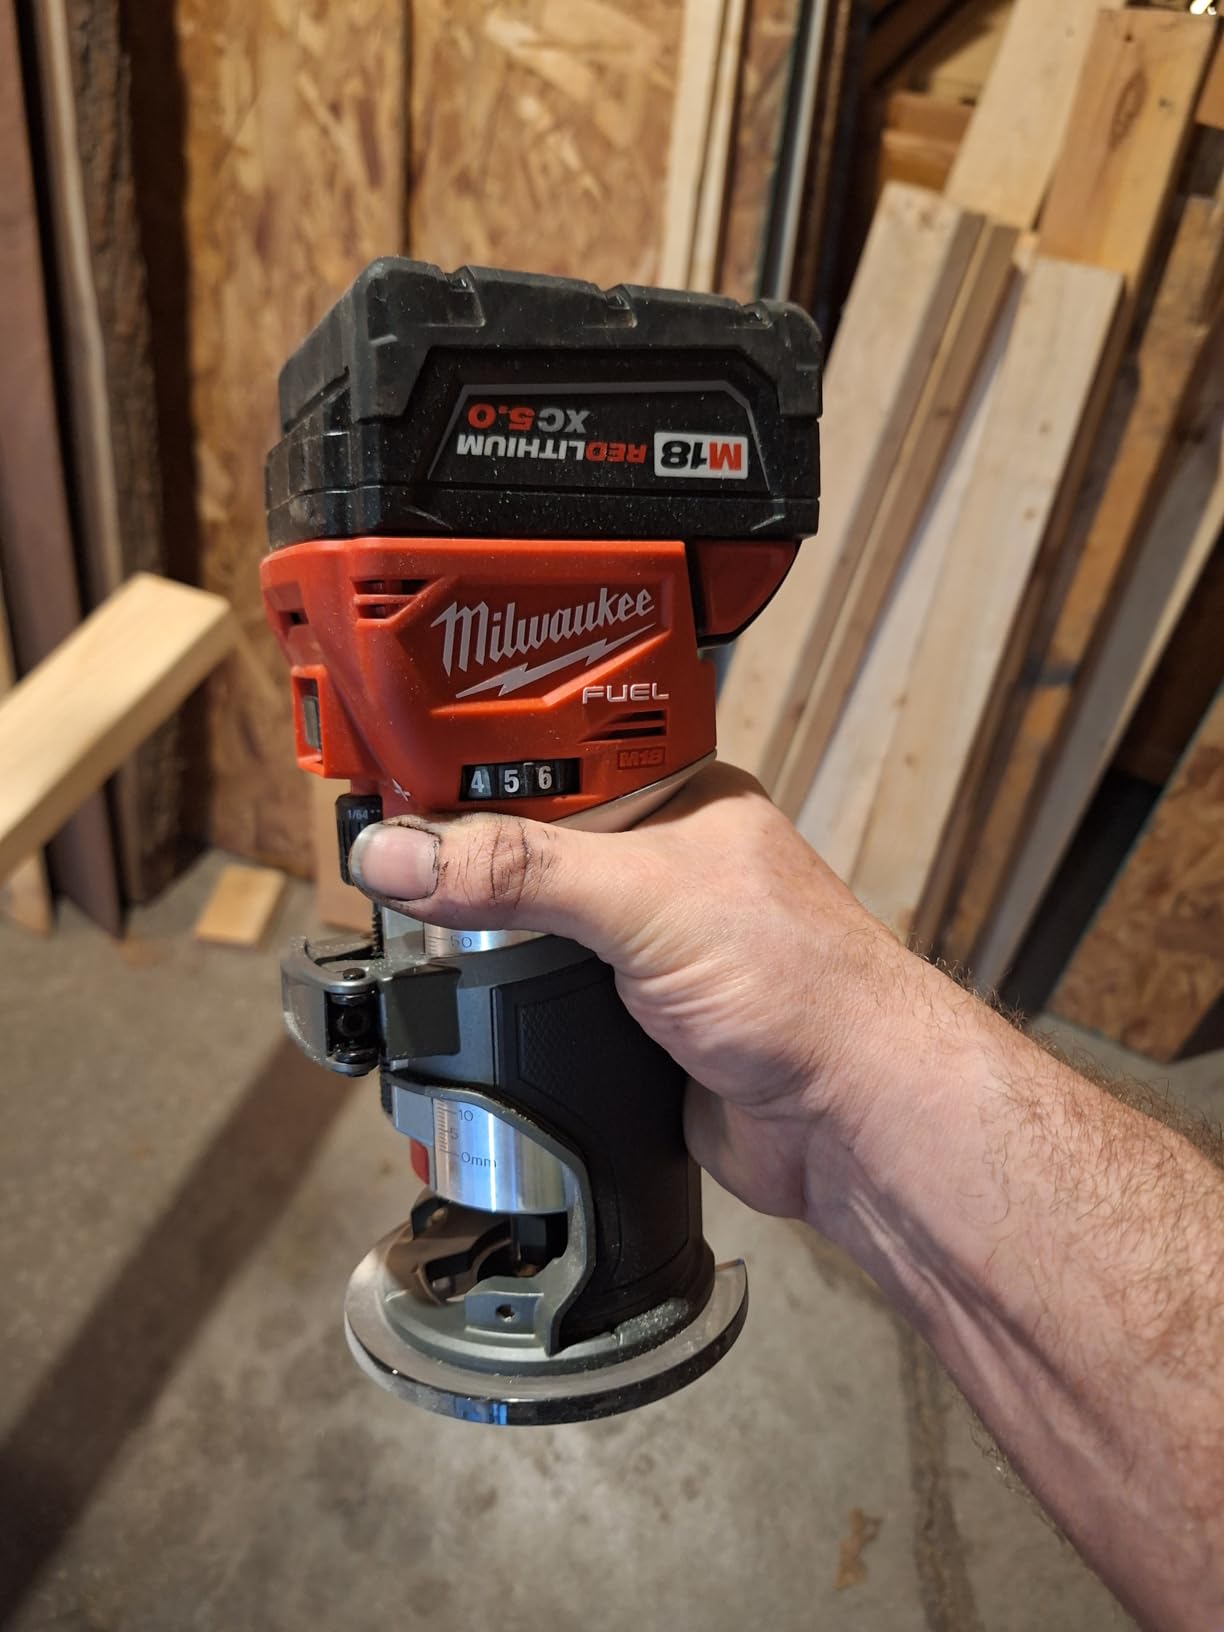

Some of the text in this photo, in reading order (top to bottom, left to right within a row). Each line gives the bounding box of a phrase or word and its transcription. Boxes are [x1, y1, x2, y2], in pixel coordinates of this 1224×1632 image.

[660, 440, 742, 471] M18
[430, 587, 655, 677] Milwaukee
[582, 682, 669, 704] FUEL
[471, 765, 552, 793] 4 5 6
[450, 934, 473, 948] 50
[459, 1110, 474, 1122] 10
[461, 1151, 497, 1168] 0mm
